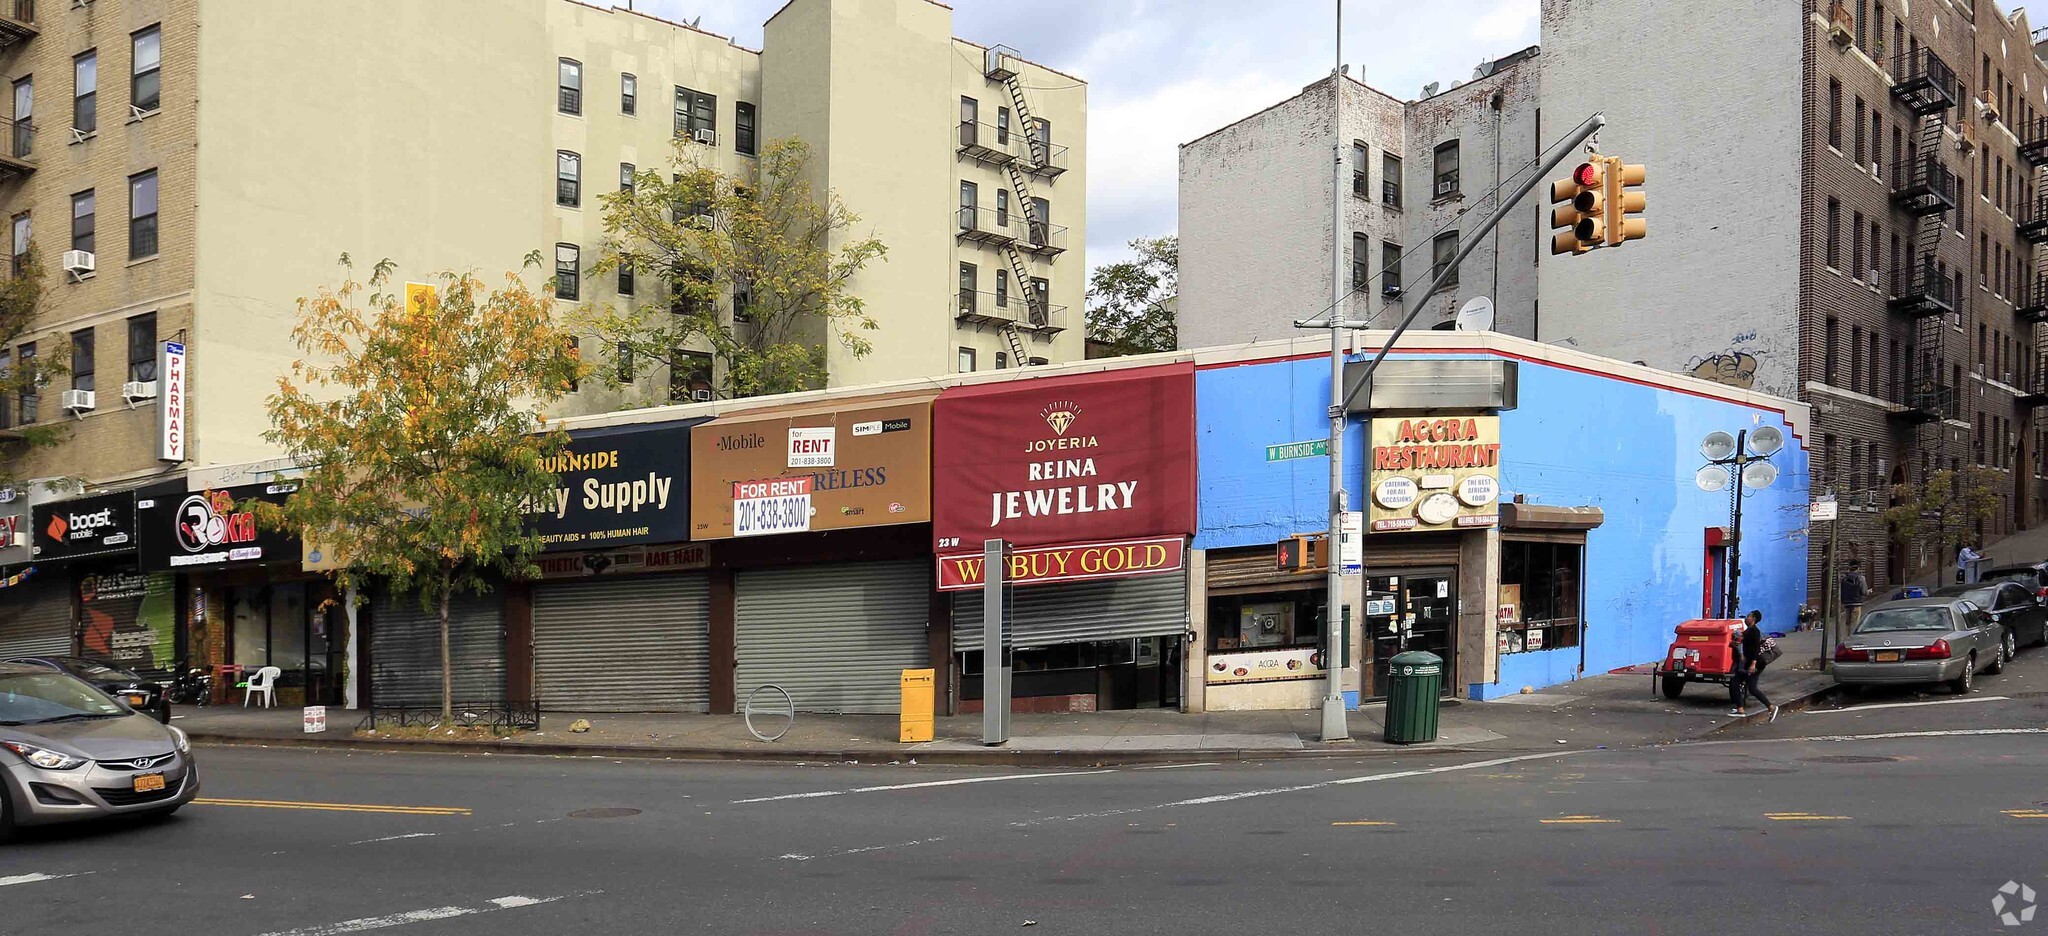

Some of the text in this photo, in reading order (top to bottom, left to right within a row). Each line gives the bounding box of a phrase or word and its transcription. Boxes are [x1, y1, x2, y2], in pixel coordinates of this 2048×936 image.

[169, 357, 180, 456] PHARMACY
[792, 430, 803, 438] for
[854, 421, 908, 433] SIMPLE Mobile
[1399, 418, 1479, 441] ACCRA
[792, 438, 831, 453] RENT
[1025, 436, 1099, 453] JOYERIA
[1269, 447, 1276, 460] W
[1279, 442, 1315, 459] BURNSIDE
[790, 457, 832, 465] 201-838-3800
[1375, 443, 1501, 470] RESTAURANT
[1028, 458, 1098, 481] REINA
[813, 467, 886, 491] RELESS
[582, 471, 672, 514] Supply
[740, 484, 767, 499] FOR
[770, 480, 806, 496] RENT
[844, 508, 865, 516] smart
[990, 480, 1138, 528] JEWELRY
[69, 508, 111, 530] boost
[739, 497, 806, 532] 201-838-3800
[70, 529, 93, 540] mobile
[563, 533, 580, 542] AIDS
[589, 531, 606, 540] 100%
[606, 529, 632, 539] HUMAN
[632, 527, 649, 536] HAIR
[938, 537, 960, 548] 23 W
[673, 547, 705, 564] HAIR
[955, 545, 1167, 583] W BUY GOLD
[1438, 583, 1446, 593] A
[1499, 607, 1514, 619] ATM
[1527, 637, 1542, 645] ATM
[1258, 659, 1280, 669] ACCRA
